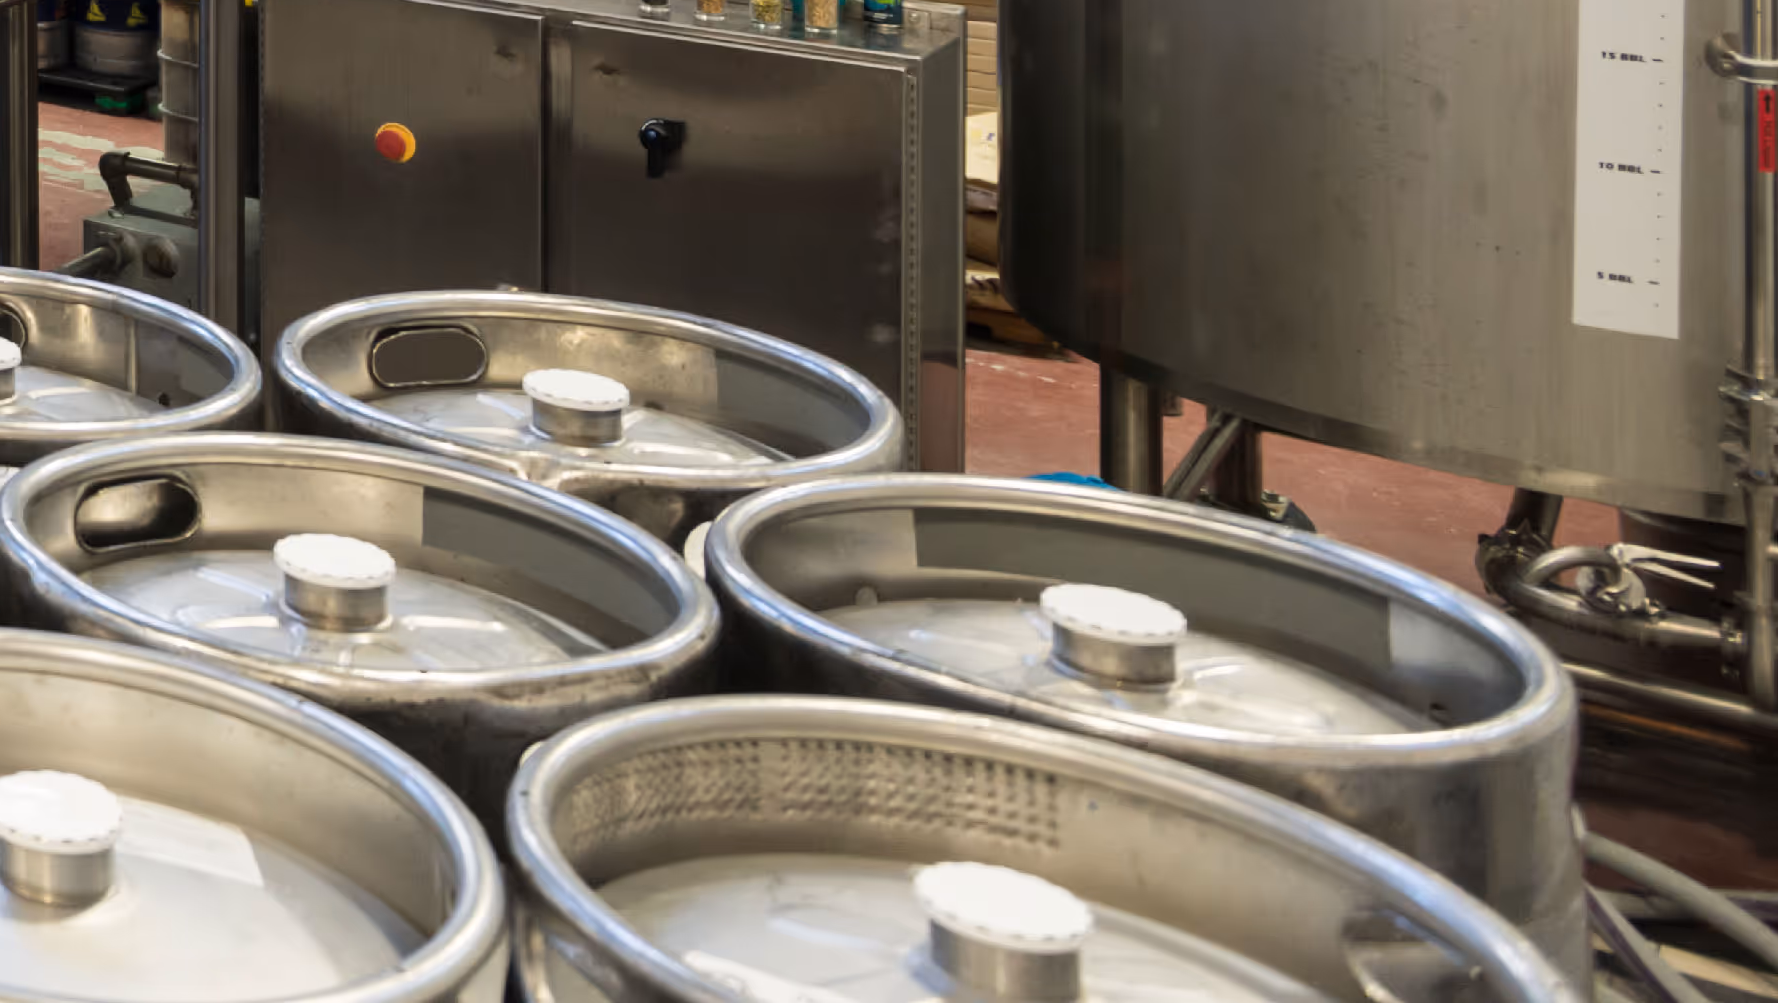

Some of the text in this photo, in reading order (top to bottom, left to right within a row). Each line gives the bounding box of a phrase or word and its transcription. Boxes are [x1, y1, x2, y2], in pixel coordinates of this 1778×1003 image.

[1601, 51, 1647, 63] 15 BBL
[1599, 161, 1644, 174] 10 BBL
[1597, 271, 1634, 283] 5 BBL
